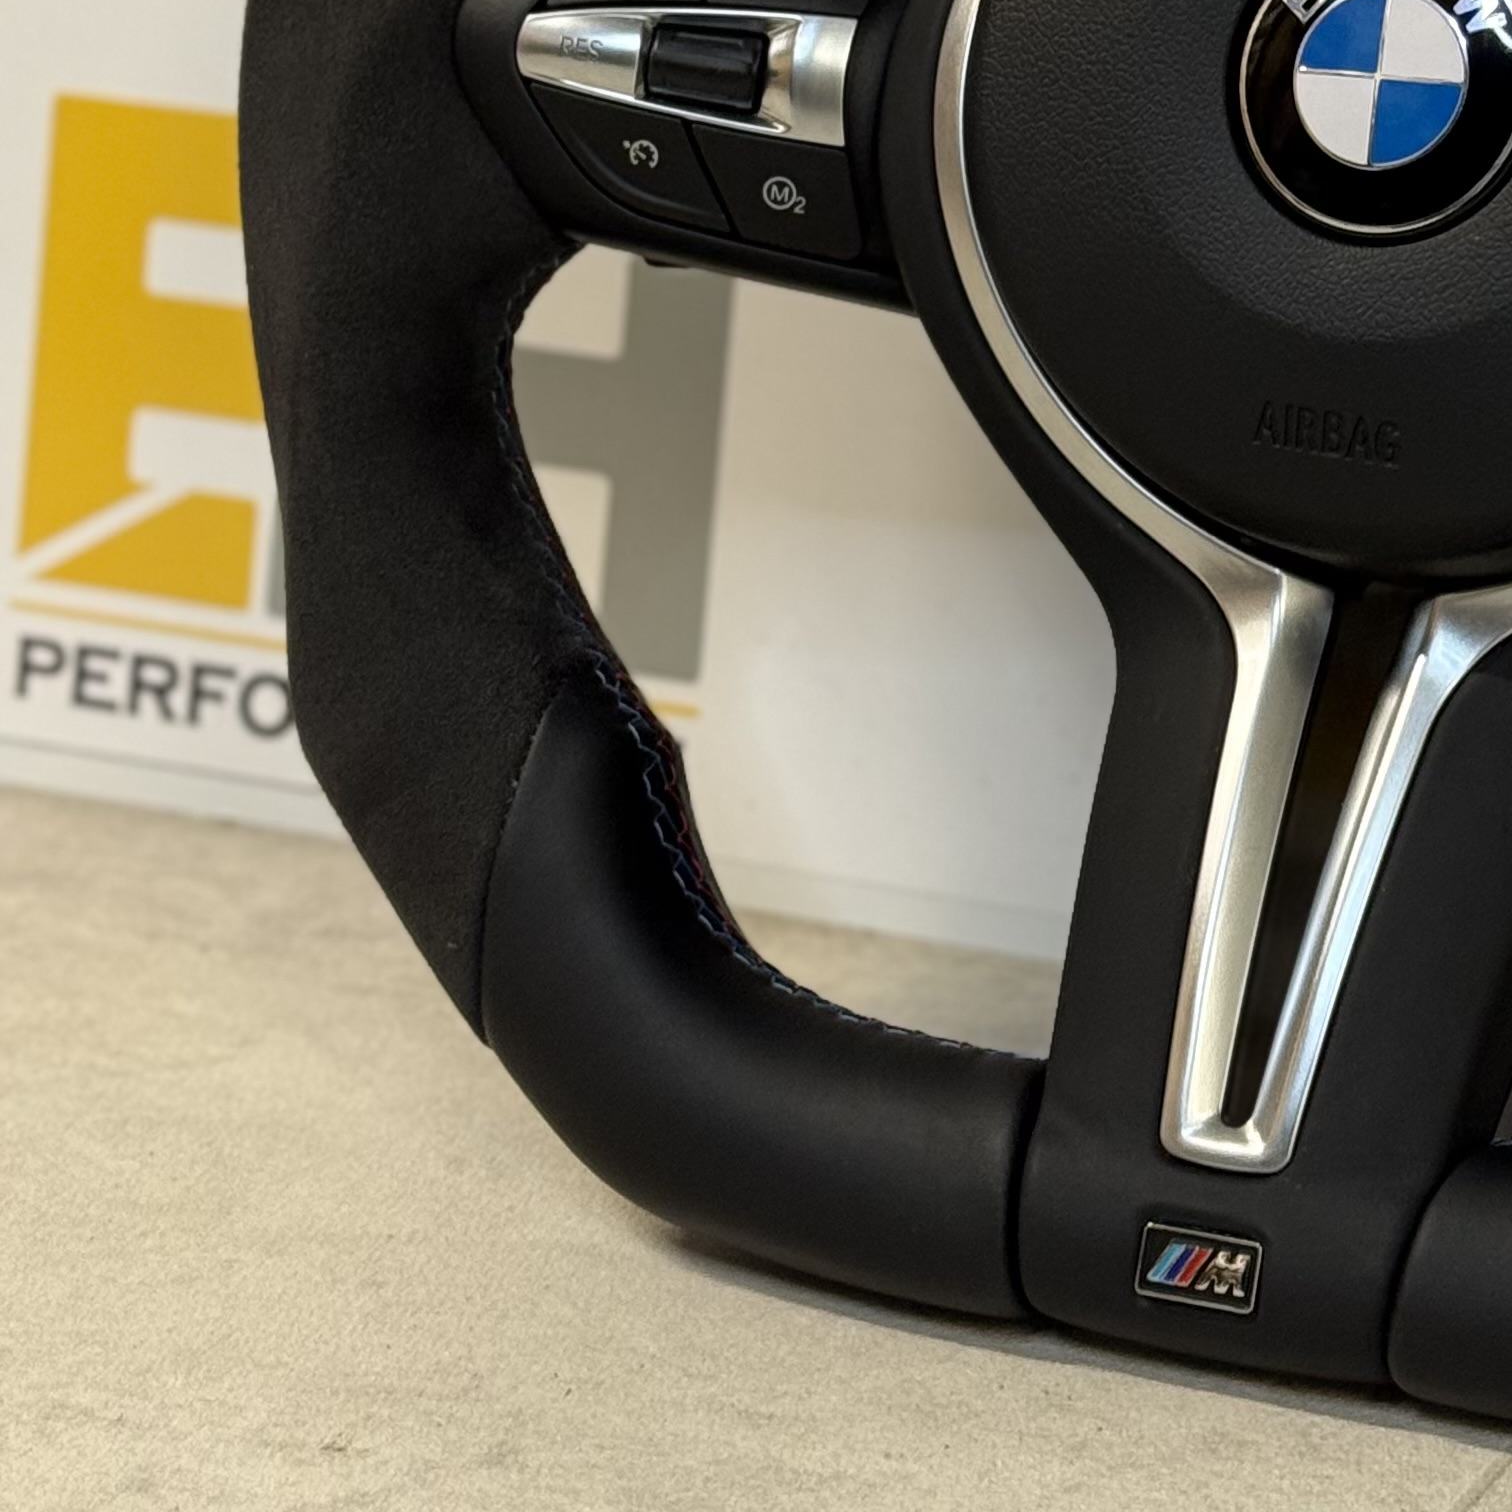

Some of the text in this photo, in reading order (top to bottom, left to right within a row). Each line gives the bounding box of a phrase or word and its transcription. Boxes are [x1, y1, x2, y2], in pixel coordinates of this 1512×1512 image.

[559, 34, 604, 63] RES
[1253, 400, 1400, 469] AIRBAG
[15, 634, 296, 739] PERFO
